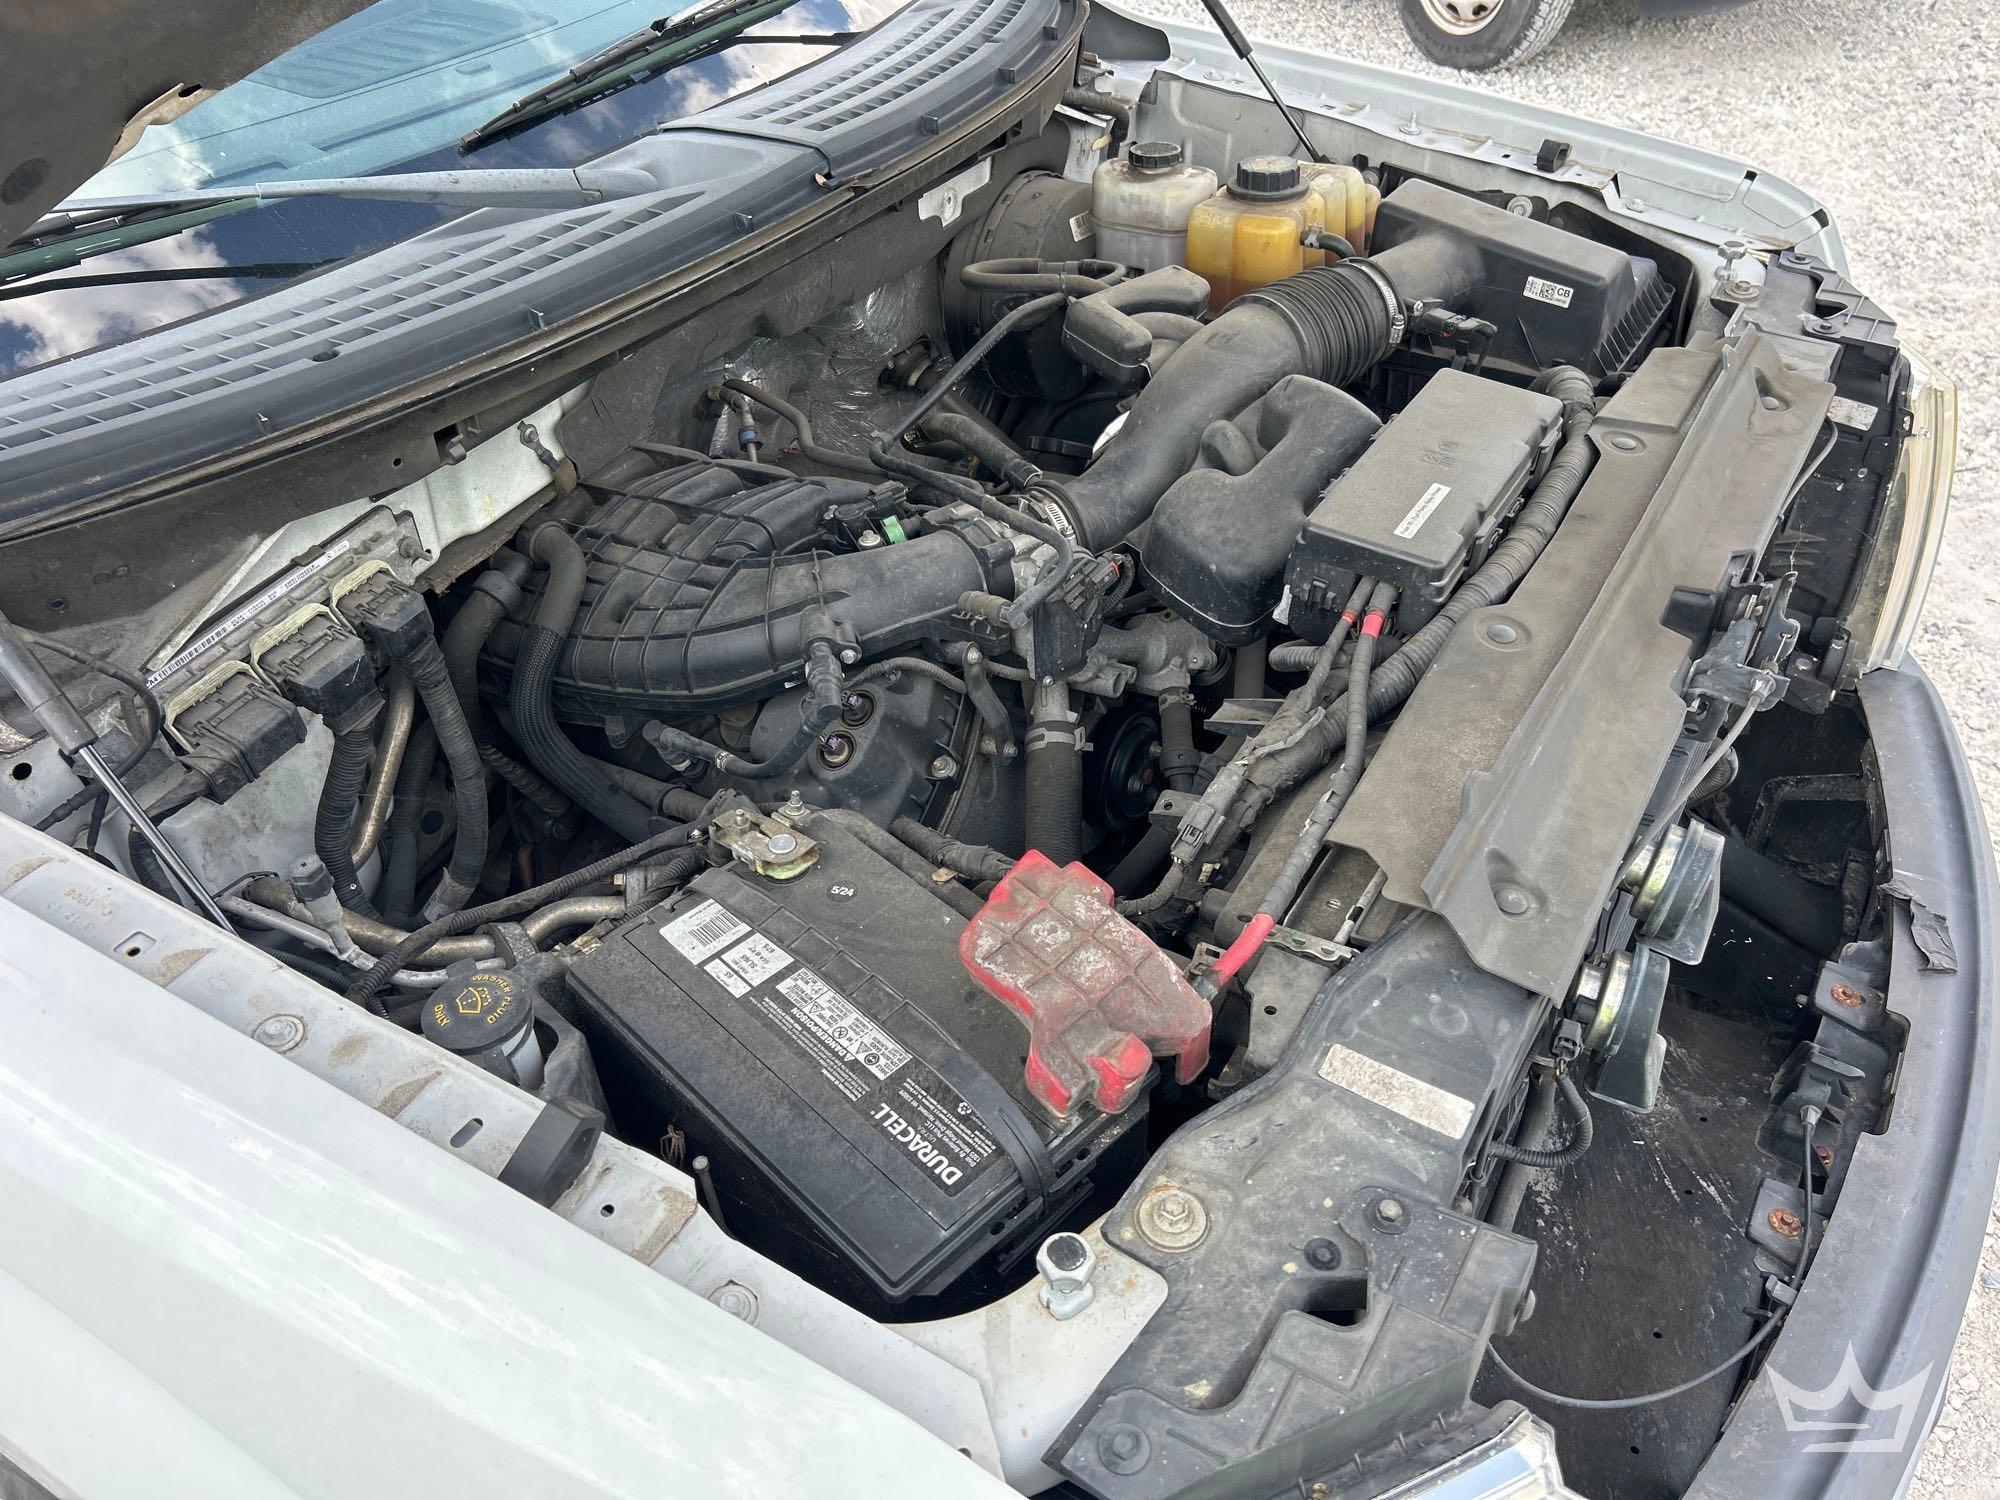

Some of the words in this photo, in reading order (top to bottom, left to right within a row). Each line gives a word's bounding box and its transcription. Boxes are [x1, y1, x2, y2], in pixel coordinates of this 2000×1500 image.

[1557, 288, 1571, 298] CB
[831, 886, 854, 896] 5/24
[472, 974, 512, 993] WASHER
[434, 1004, 450, 1026] ONLY
[486, 996, 512, 1024] FLUID
[788, 1006, 848, 1056] DANGER/POISON
[915, 1124, 937, 1143] ULTRA
[874, 1103, 963, 1186] DURACELL
